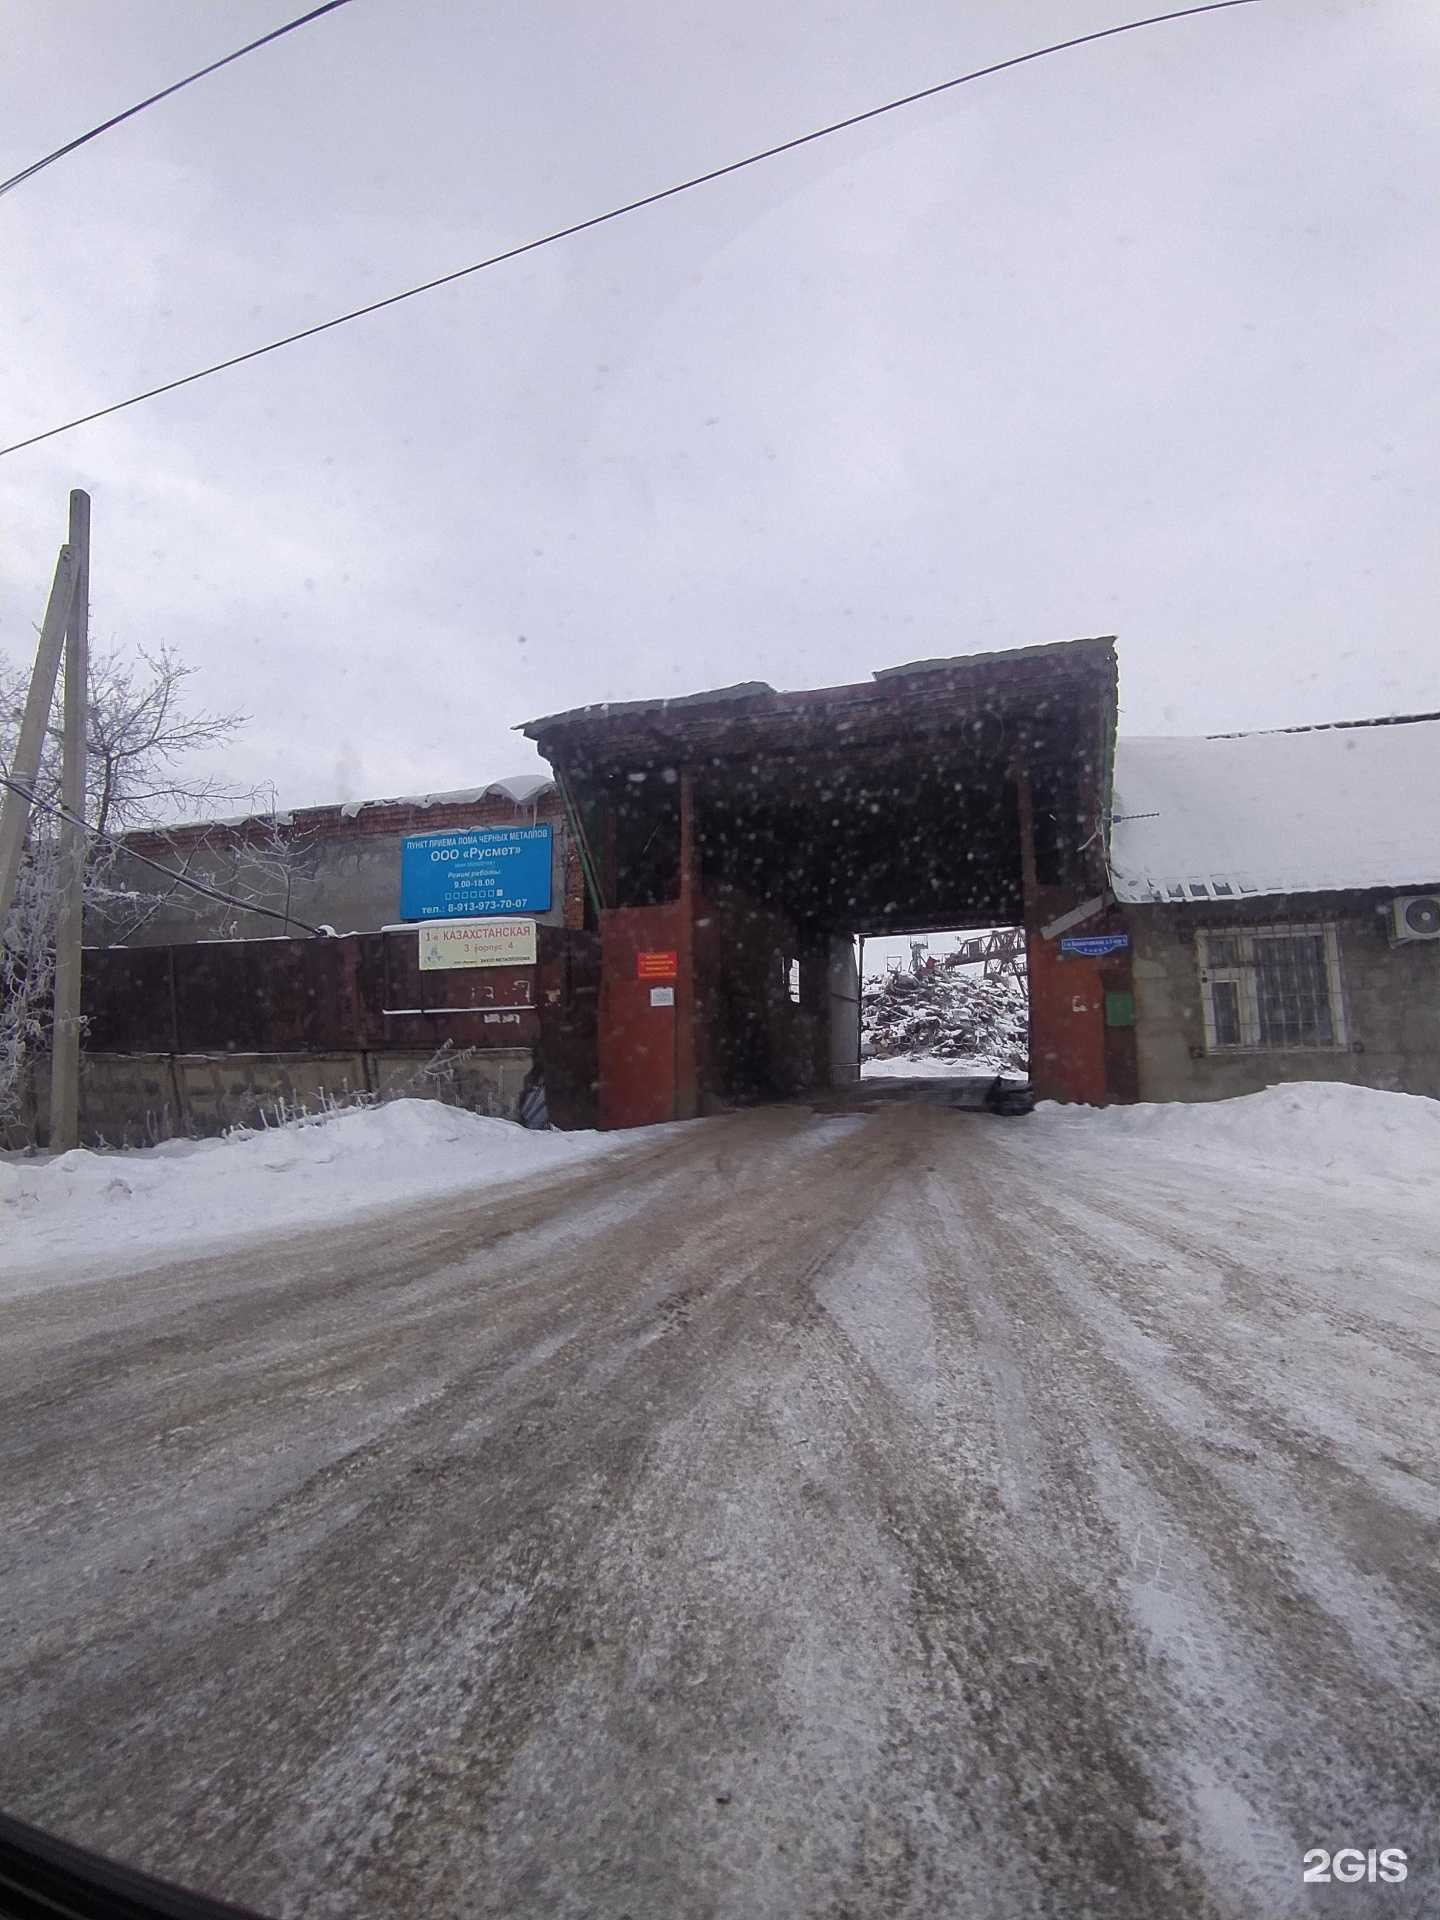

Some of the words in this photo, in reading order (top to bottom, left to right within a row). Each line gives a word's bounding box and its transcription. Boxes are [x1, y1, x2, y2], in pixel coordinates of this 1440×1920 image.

[407, 840, 427, 849] ПУНКТ
[428, 838, 457, 848] ПРИЕМА
[458, 836, 478, 845] ЛОМА
[479, 832, 509, 843] ЧЕРНЫХ
[509, 829, 548, 841] МЕТАЛЛОВ
[431, 849, 459, 862] ООО
[463, 847, 521, 861] «Русмет»
[448, 898, 528, 913] 8-913-973-70-07
[443, 926, 530, 941] КАЗАХСТАНСКАЯ
